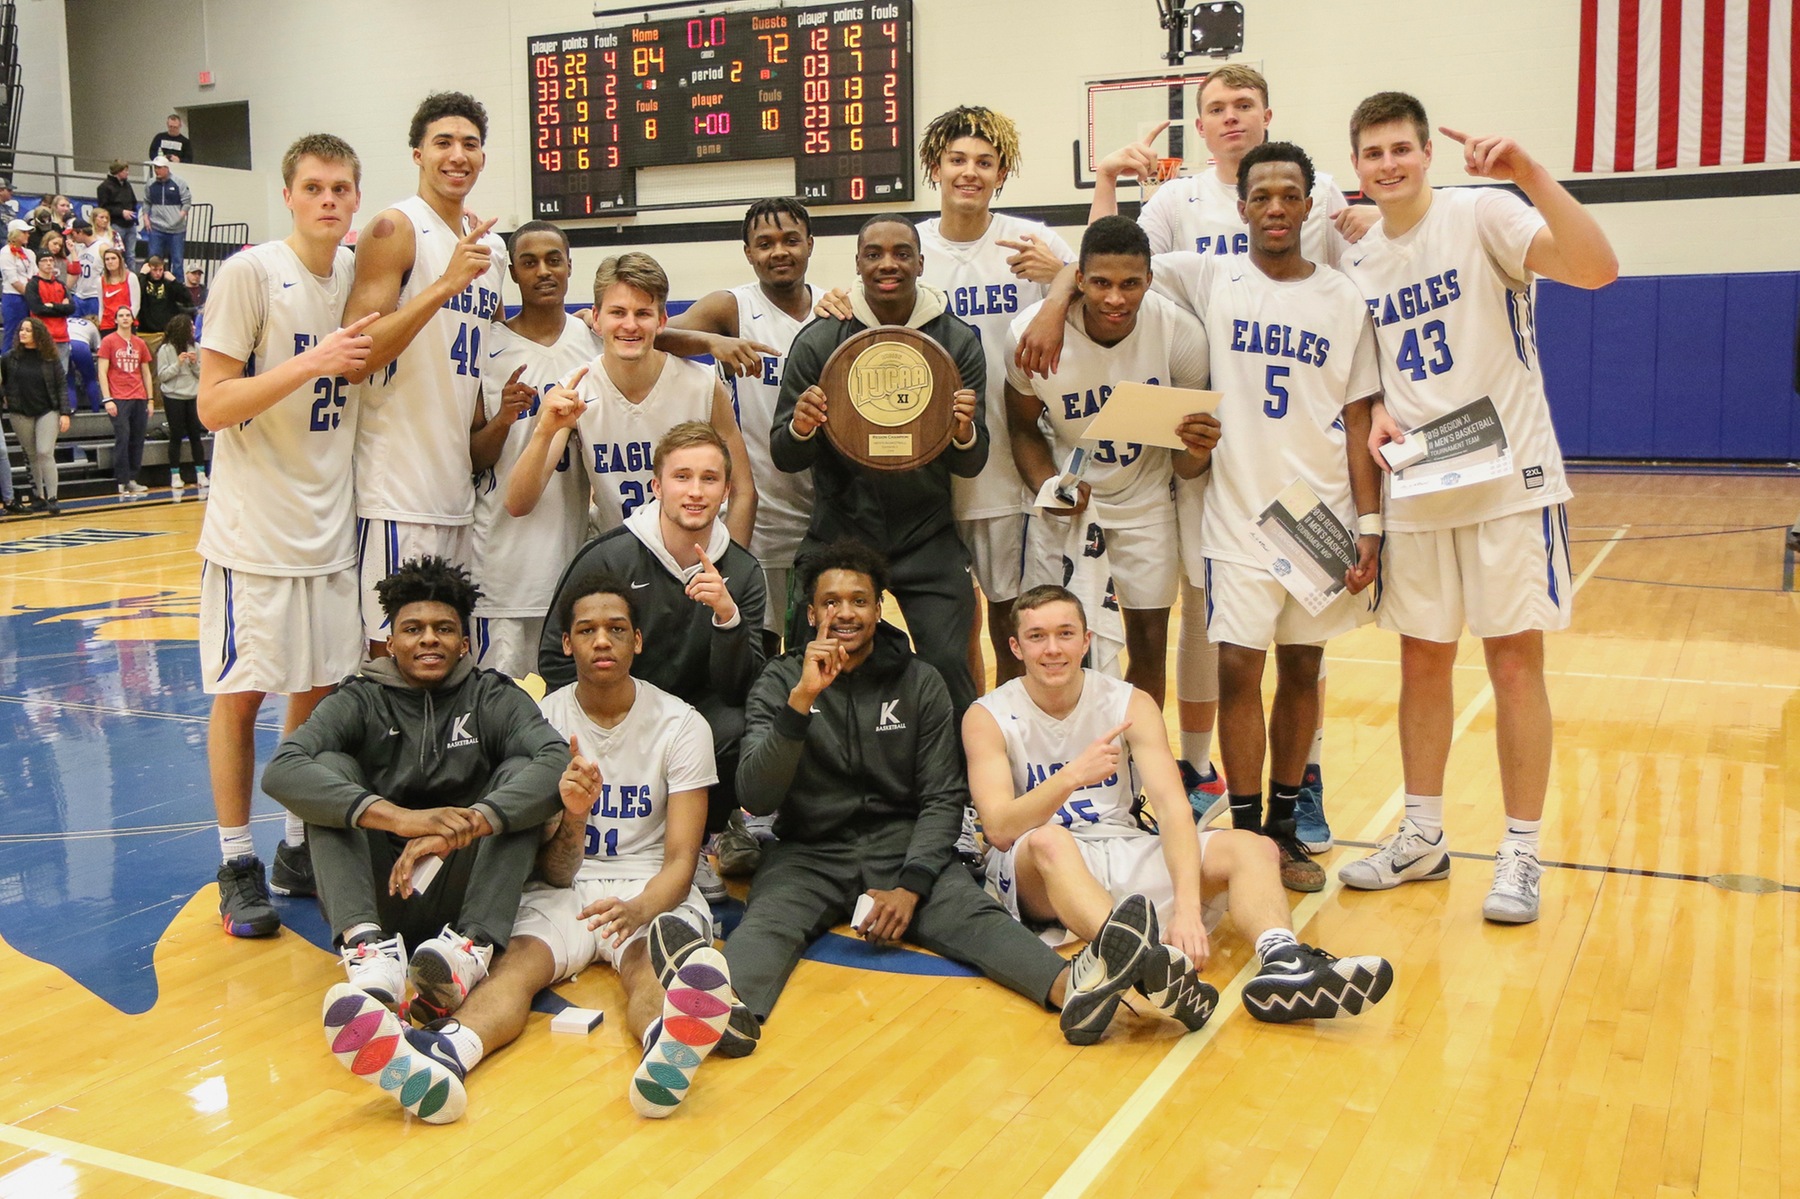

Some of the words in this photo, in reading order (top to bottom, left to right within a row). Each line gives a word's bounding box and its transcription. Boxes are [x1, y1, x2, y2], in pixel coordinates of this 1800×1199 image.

[752, 15, 787, 31] Guests
[797, 12, 828, 28] player
[833, 7, 863, 24] points
[871, 4, 899, 20] fouls
[532, 41, 558, 55] player
[562, 36, 588, 52] points
[594, 33, 618, 48] fouls
[632, 28, 659, 43] Home
[687, 17, 726, 48] 0.0
[811, 28, 829, 51] 12
[843, 24, 862, 48] 12
[882, 23, 897, 43] 4
[757, 33, 789, 63] 72
[536, 56, 559, 78] 05
[564, 53, 587, 75] 22
[604, 51, 616, 70] 4
[633, 47, 664, 76] 84
[730, 61, 742, 83] 2
[803, 54, 829, 78] 03
[850, 50, 863, 72] 7
[890, 49, 897, 69] 1
[691, 66, 724, 83] period
[537, 80, 560, 101] 33
[565, 77, 588, 99] 27
[605, 74, 617, 96] 2
[758, 88, 782, 103] fouls
[803, 79, 829, 103] 00
[844, 76, 863, 99] 13
[883, 73, 896, 97] 2
[537, 103, 560, 125] 25
[576, 100, 589, 122] 9
[605, 98, 617, 120] 2
[636, 99, 658, 113] fouls
[691, 93, 724, 109] player
[761, 108, 779, 131] 10
[804, 105, 830, 129] 23
[844, 102, 863, 125] 10
[884, 100, 897, 123] 3
[538, 128, 561, 149] 21
[572, 126, 589, 145] 14
[612, 123, 618, 142] 1
[645, 118, 657, 140] 8
[804, 131, 830, 154] 25
[850, 128, 863, 151] 6
[891, 127, 898, 147] 1
[539, 150, 561, 171] 43
[578, 149, 590, 170] 6
[607, 146, 619, 168] 3
[696, 143, 722, 158] game
[850, 178, 864, 200] 0
[585, 194, 591, 214] 1
[1196, 233, 1248, 255] EAG
[1231, 319, 1330, 368] EAGLES
[1396, 319, 1453, 381] 43
[897, 394, 909, 404] XI
[1263, 365, 1290, 419] 5
[1434, 432, 1455, 448] MEN'S
[1455, 416, 1495, 439] BASKETBALL
[1439, 417, 1463, 437] REGION
[1463, 413, 1471, 425] XI
[1430, 441, 1464, 458] TOURNAMENT
[1465, 435, 1480, 447] TEAM
[1525, 467, 1542, 476] 2XL
[1295, 522, 1324, 553] TOURNAMENT
[1321, 548, 1332, 559] MVP
[1307, 519, 1328, 540] MEN'S
[1322, 517, 1344, 541] REGION
[1341, 538, 1349, 548] XI
[880, 698, 901, 726] K
[452, 712, 473, 741] K
[875, 722, 907, 732] BASKETBALL
[446, 737, 479, 749] BASKETBALL
